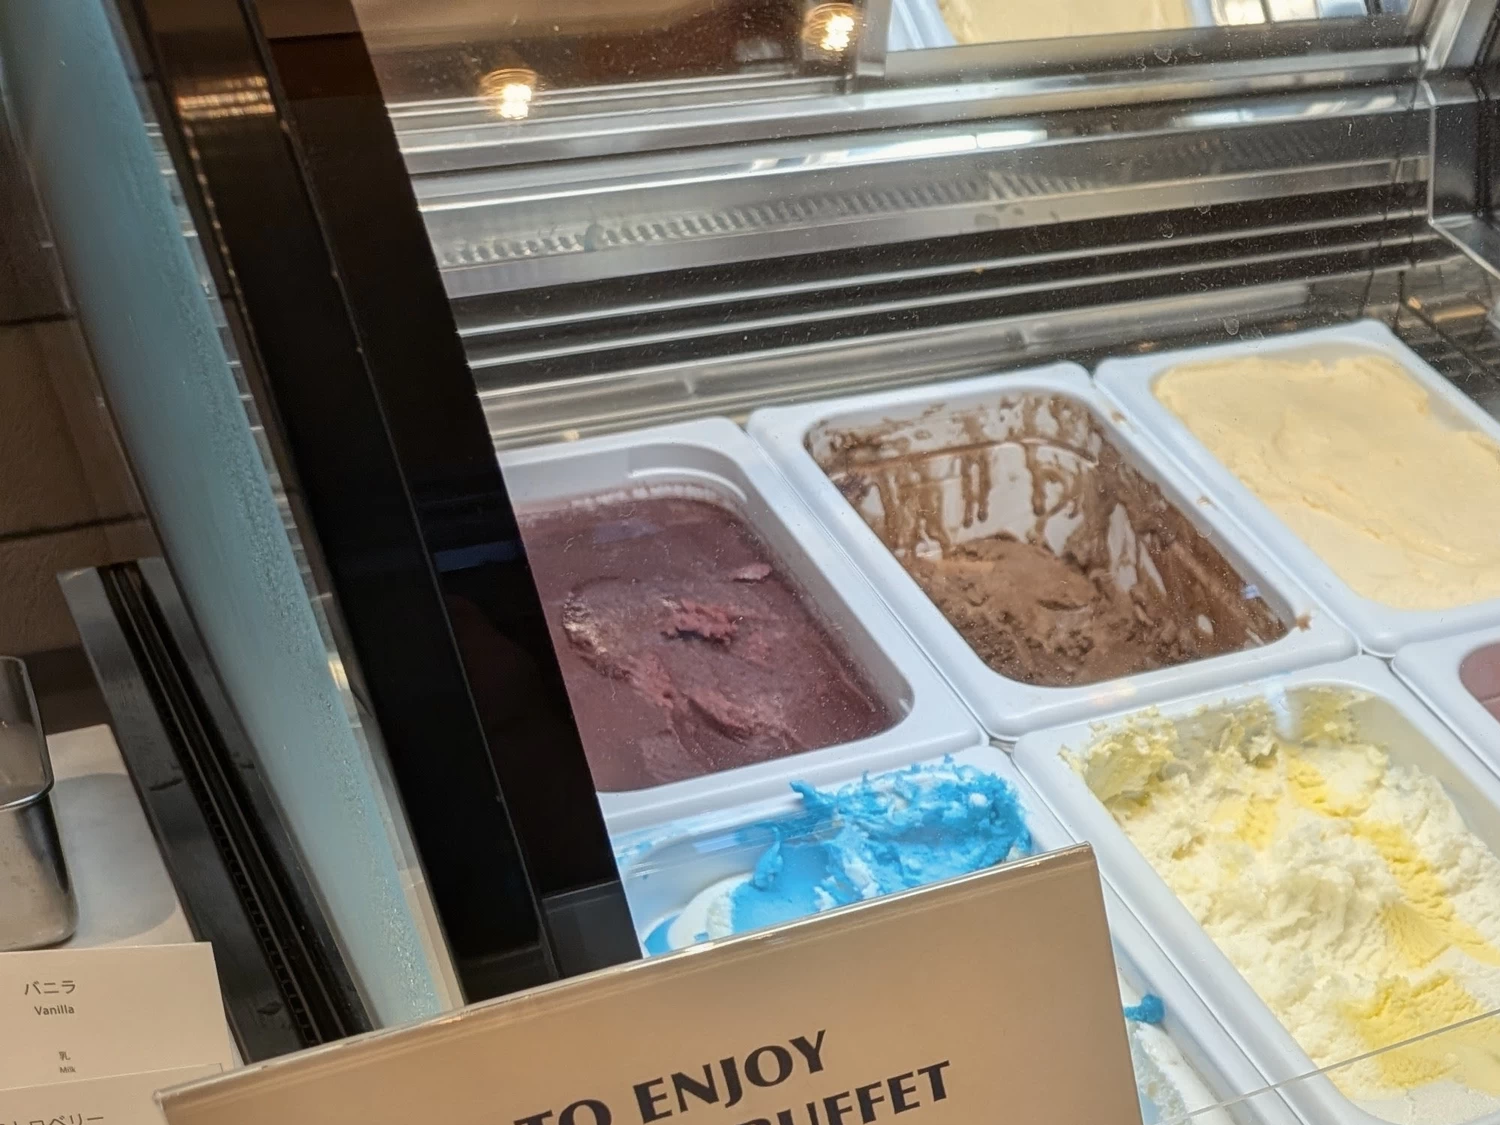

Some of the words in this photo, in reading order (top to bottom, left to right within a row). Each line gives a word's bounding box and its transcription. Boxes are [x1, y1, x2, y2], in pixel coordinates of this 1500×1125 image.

[33, 1004, 75, 1016] Vanilla
[59, 1065, 77, 1074] Milk
[631, 1028, 827, 1125] ENJOY
